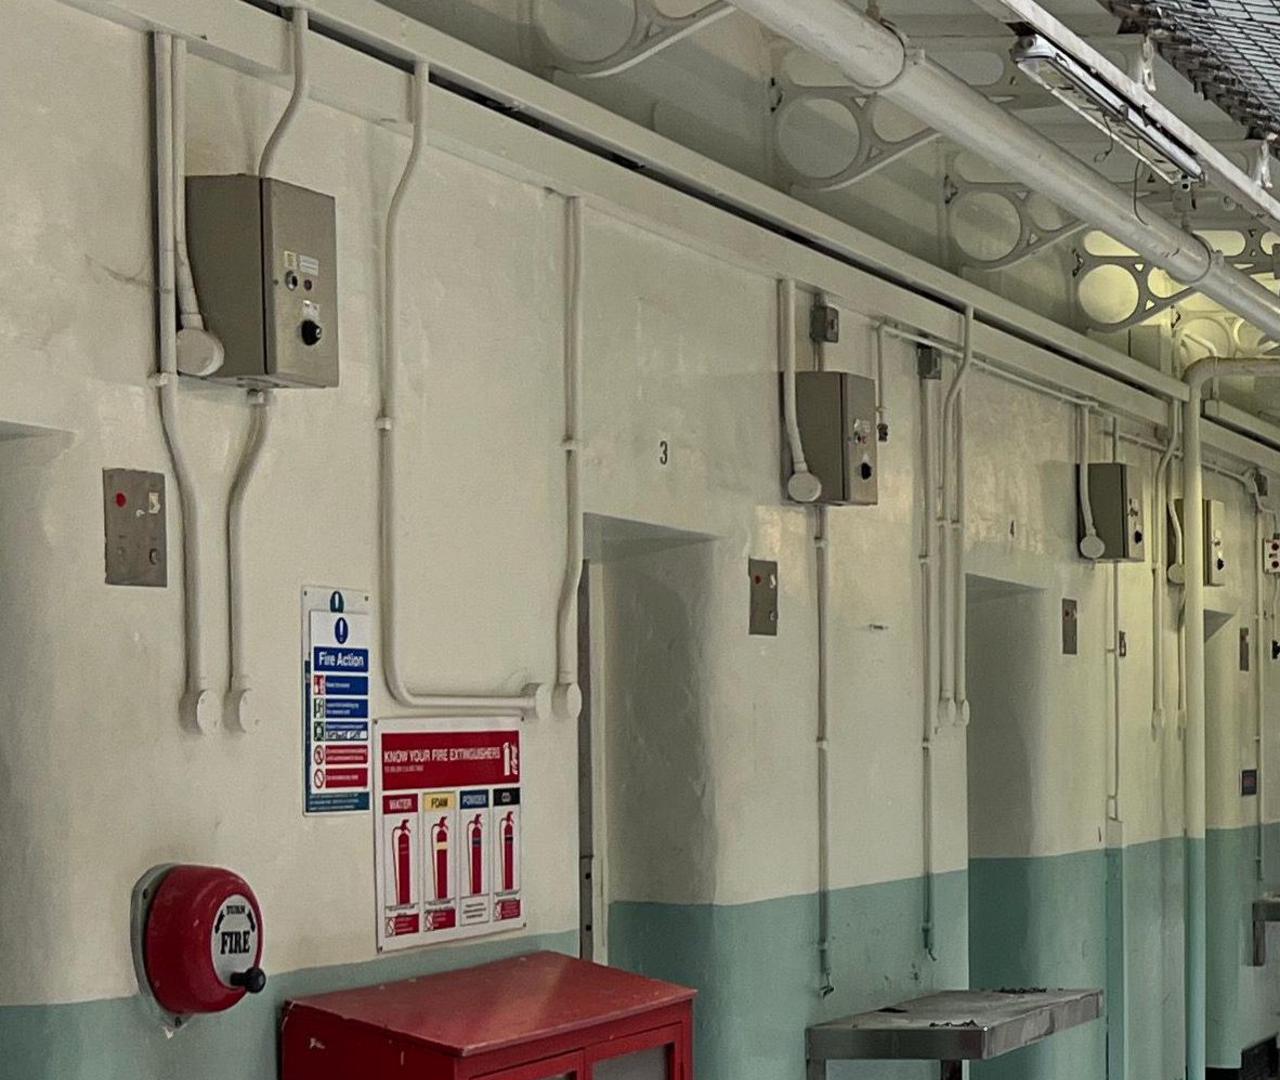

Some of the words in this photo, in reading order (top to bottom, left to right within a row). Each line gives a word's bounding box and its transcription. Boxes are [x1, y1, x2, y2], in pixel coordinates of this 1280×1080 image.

[659, 440, 668, 465] 3
[318, 651, 336, 666] Fire
[337, 652, 365, 667] Action
[383, 750, 408, 763] KNOW
[409, 749, 431, 762] YOUR
[431, 748, 448, 761] FIRE
[431, 796, 449, 808] FOAM
[220, 930, 251, 955] FIRE
